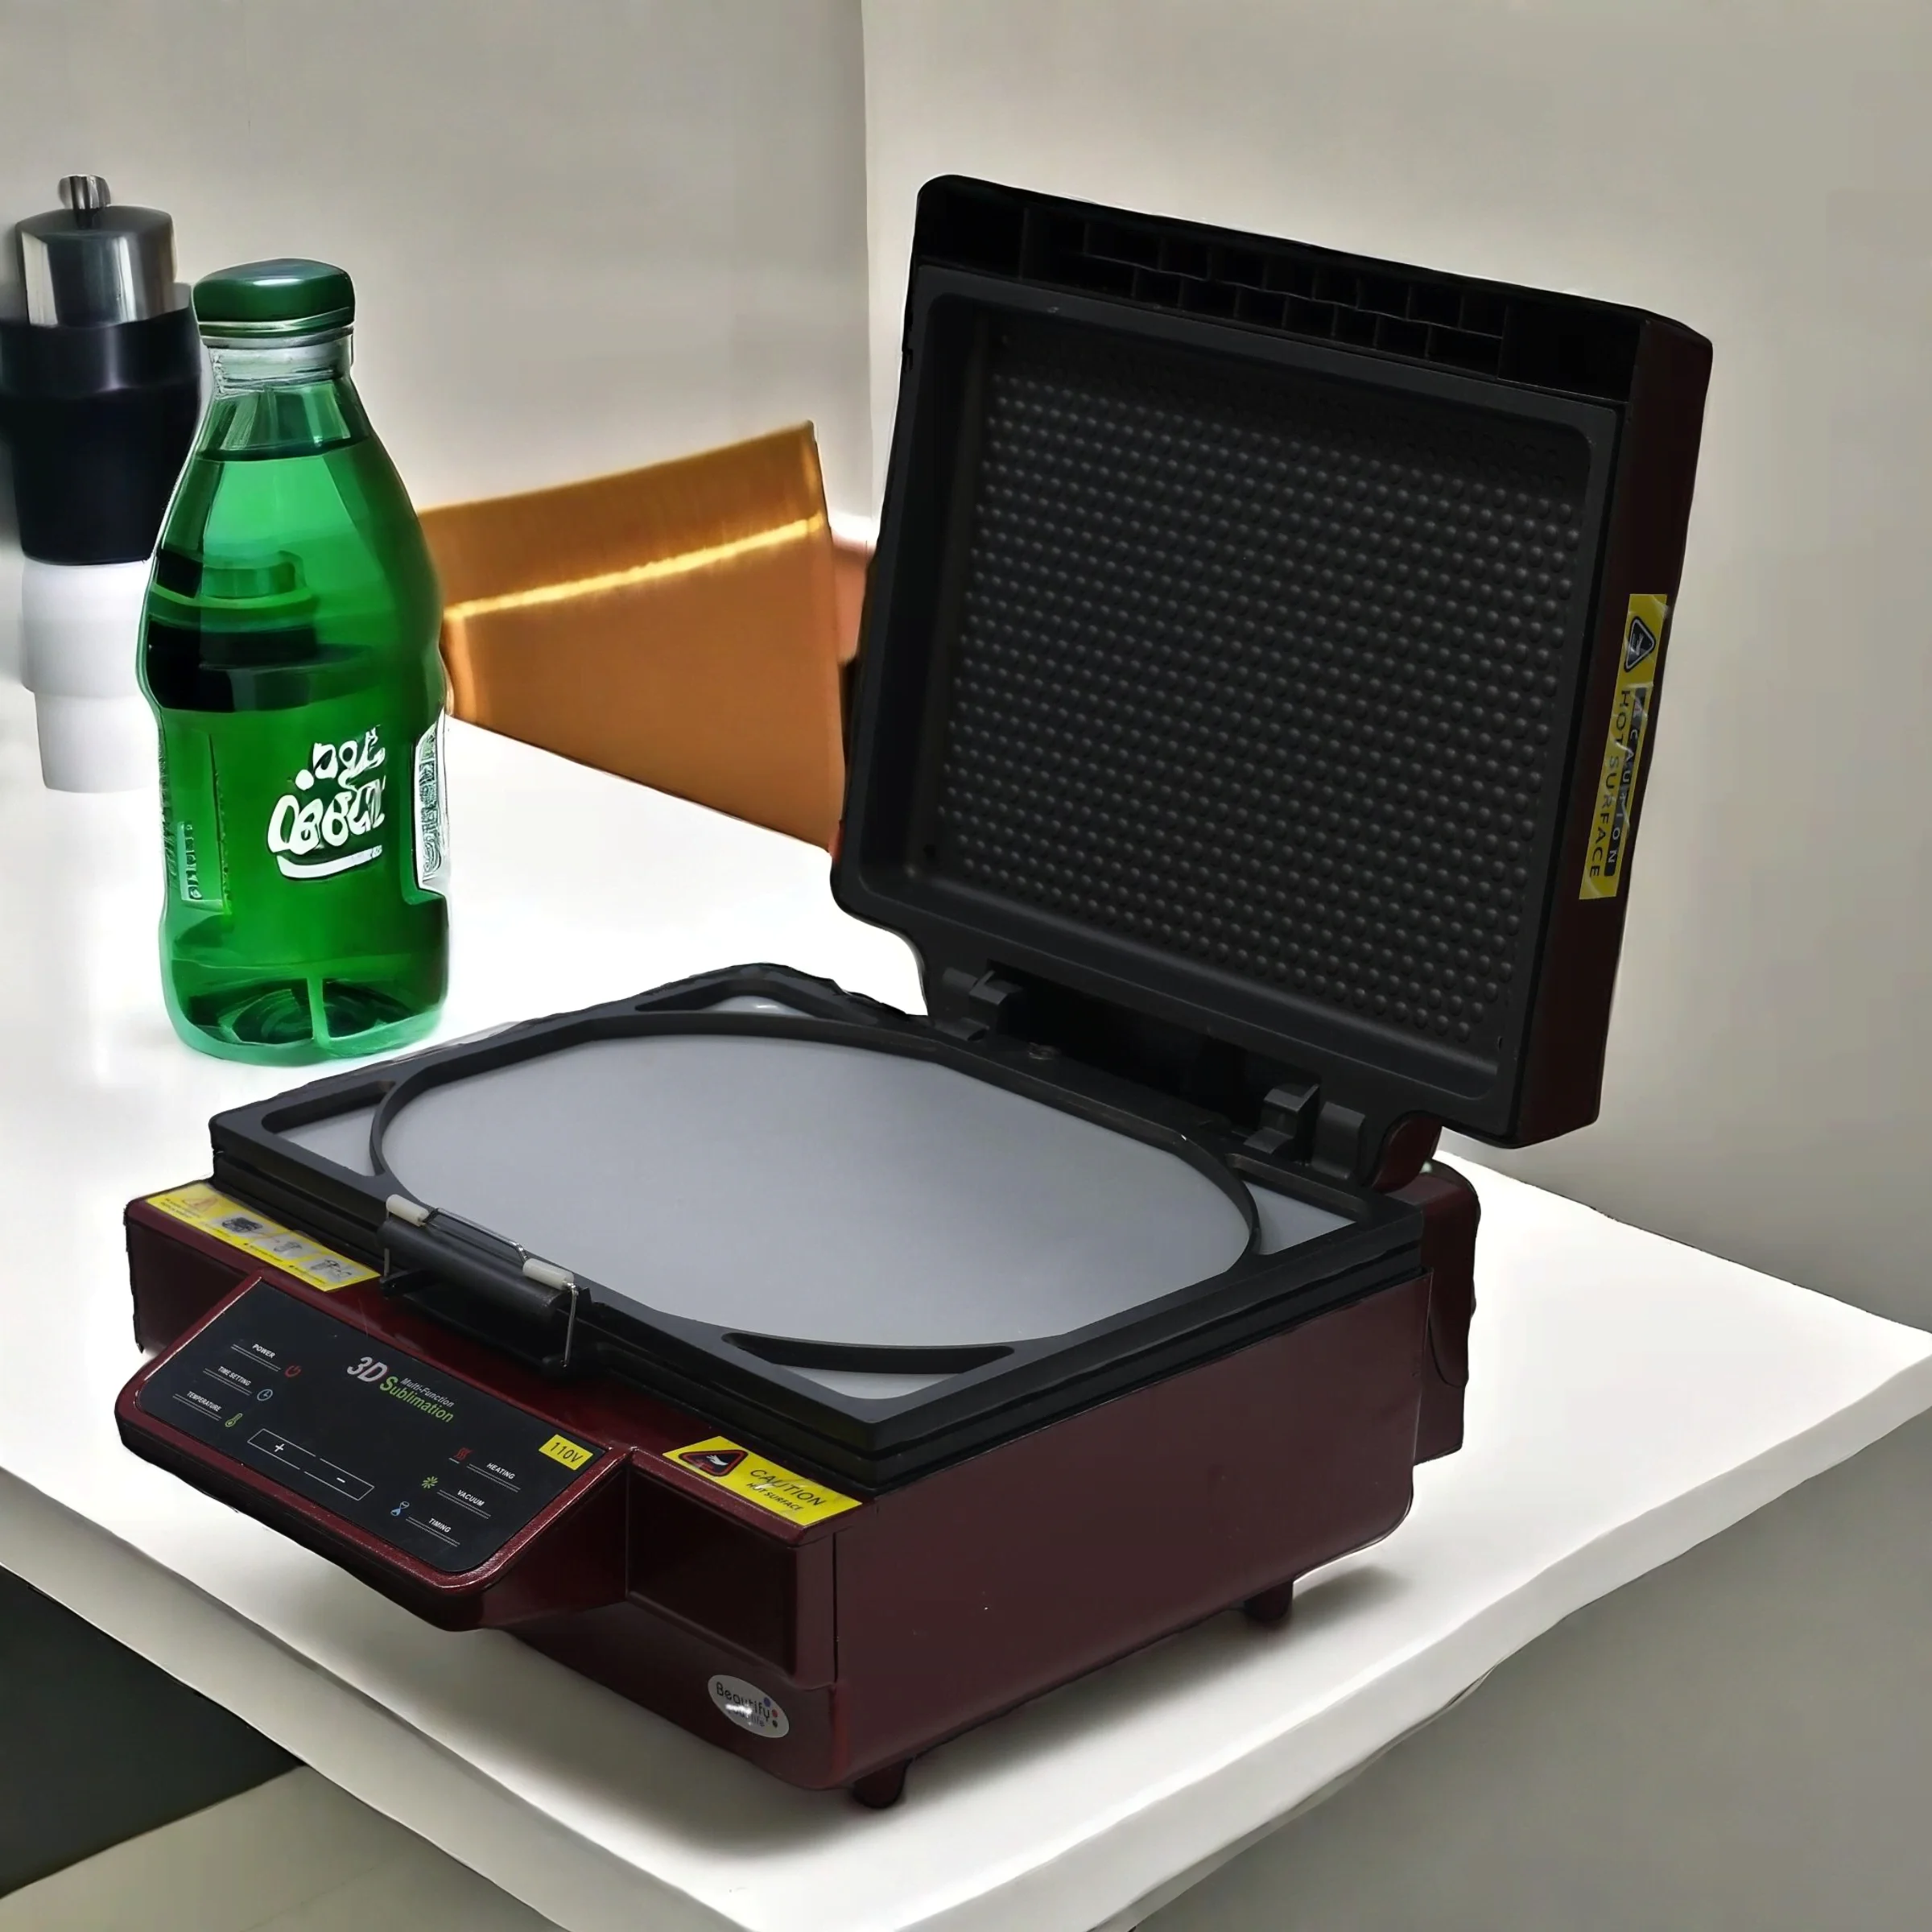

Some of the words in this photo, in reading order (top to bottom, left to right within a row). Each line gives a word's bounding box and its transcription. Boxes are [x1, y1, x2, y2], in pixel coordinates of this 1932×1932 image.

[1608, 729, 1638, 863] CAUTION
[252, 1344, 275, 1359] POWER
[217, 1365, 230, 1377] TIME
[229, 1371, 252, 1386] SETTING
[346, 1356, 388, 1382] 3D
[187, 1390, 222, 1412] TEMPERATURE
[379, 1376, 454, 1423] Sublimation
[400, 1377, 455, 1408] Multi-Function
[549, 1442, 584, 1463] 110V
[486, 1463, 516, 1480] HEATING
[456, 1489, 485, 1507] VACUUM
[749, 1469, 827, 1507] CAUTION
[764, 1492, 803, 1510] SURFACE
[428, 1517, 452, 1534] TIMING
